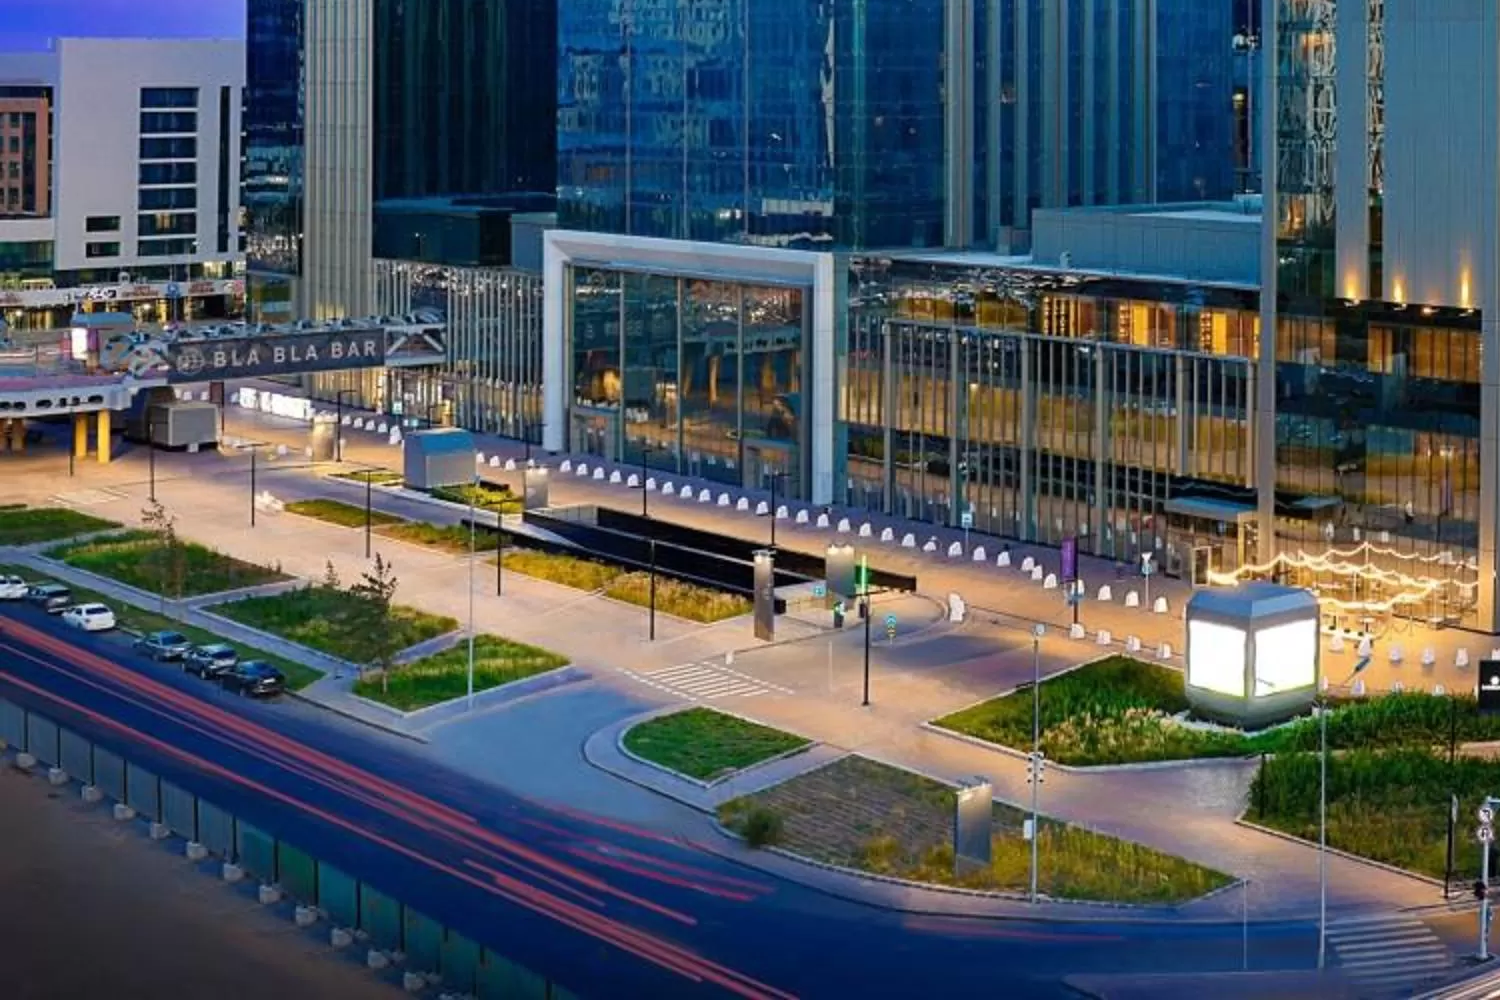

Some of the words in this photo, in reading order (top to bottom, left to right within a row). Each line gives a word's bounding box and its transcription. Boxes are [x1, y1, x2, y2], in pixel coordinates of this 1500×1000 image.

[213, 348, 260, 369] BLA
[272, 343, 319, 364] BLA
[331, 340, 377, 360] BAR
